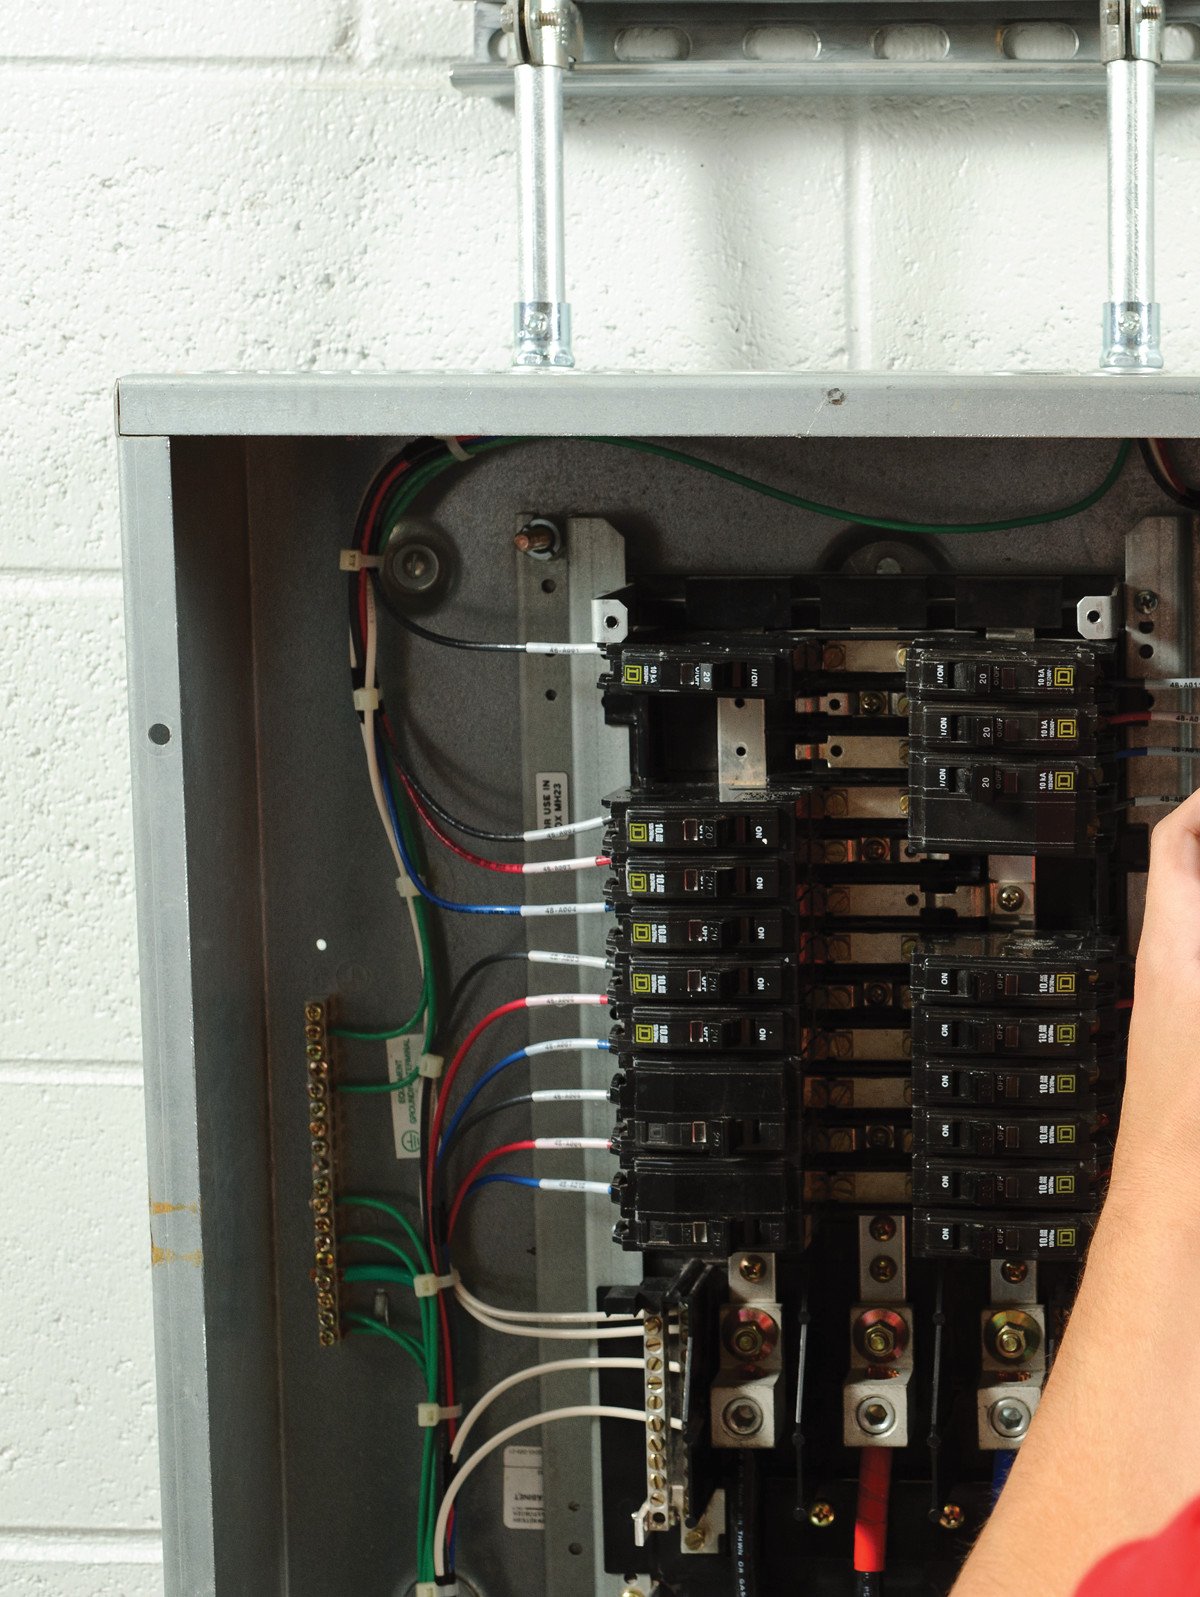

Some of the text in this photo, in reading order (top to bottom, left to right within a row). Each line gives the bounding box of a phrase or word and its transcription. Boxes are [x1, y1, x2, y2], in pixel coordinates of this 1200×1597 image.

[650, 665, 657, 674] 10
[703, 671, 711, 682] 20
[979, 673, 987, 684] 20
[1038, 668, 1045, 686] 10 kA
[983, 726, 990, 737] 20
[1041, 720, 1048, 737] 10 kA
[542, 780, 550, 790] IN
[982, 777, 990, 788] 20
[1039, 772, 1046, 790] 10 kA
[553, 783, 562, 812] MH23
[543, 794, 551, 815] USE
[705, 825, 713, 840] 20
[755, 825, 762, 839] ON
[756, 876, 763, 890] ON
[757, 926, 764, 940] ON
[757, 977, 764, 990] ON
[941, 972, 948, 985] ON
[759, 1028, 766, 1041] ON
[941, 1024, 948, 1037] ON
[941, 1075, 949, 1088] ON
[942, 1124, 949, 1137] ON
[942, 1175, 949, 1188] ON
[942, 1228, 949, 1240] ON
